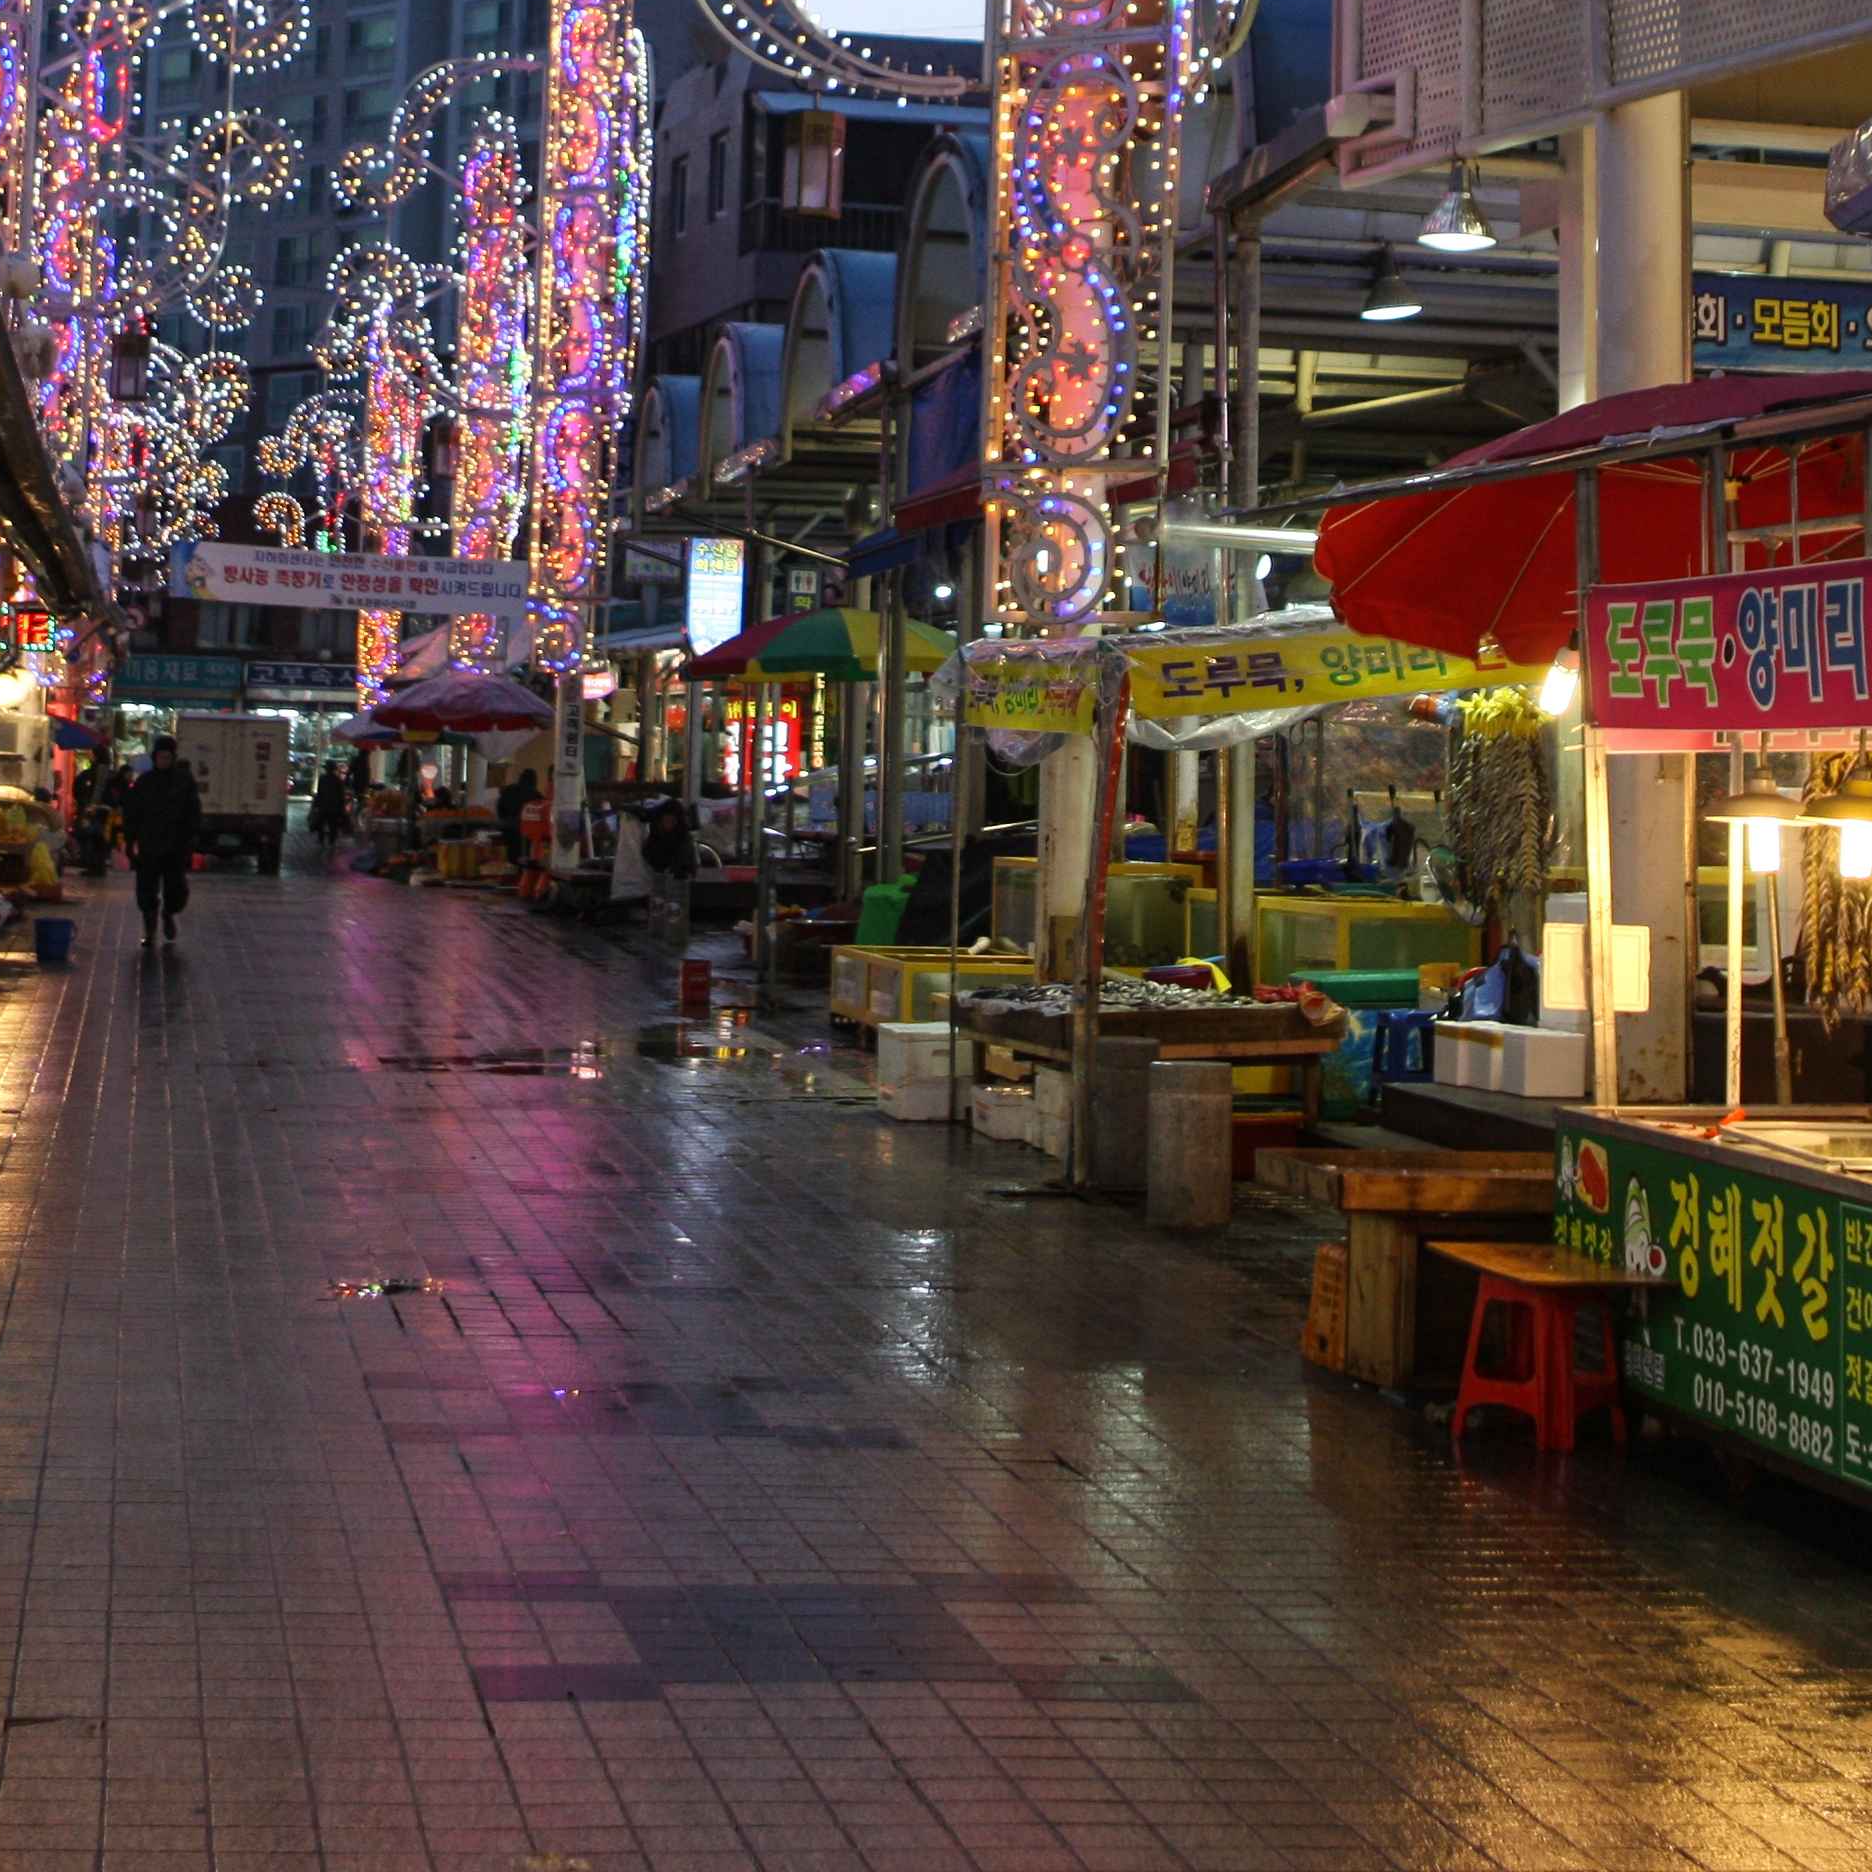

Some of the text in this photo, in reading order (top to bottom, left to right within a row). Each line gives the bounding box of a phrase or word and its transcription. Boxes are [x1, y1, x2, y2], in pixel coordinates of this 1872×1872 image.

[1692, 297, 1726, 344] 회
[1752, 297, 1839, 350] 모듬회
[224, 565, 269, 585] 방사능
[340, 573, 403, 594] 안정성을
[1159, 649, 1305, 701] 도루묵,
[1668, 1173, 1835, 1342] 정혜젓갈
[1675, 1317, 1836, 1410] T.033-637-1949
[1693, 1373, 1836, 1466] 010-5168-8882
